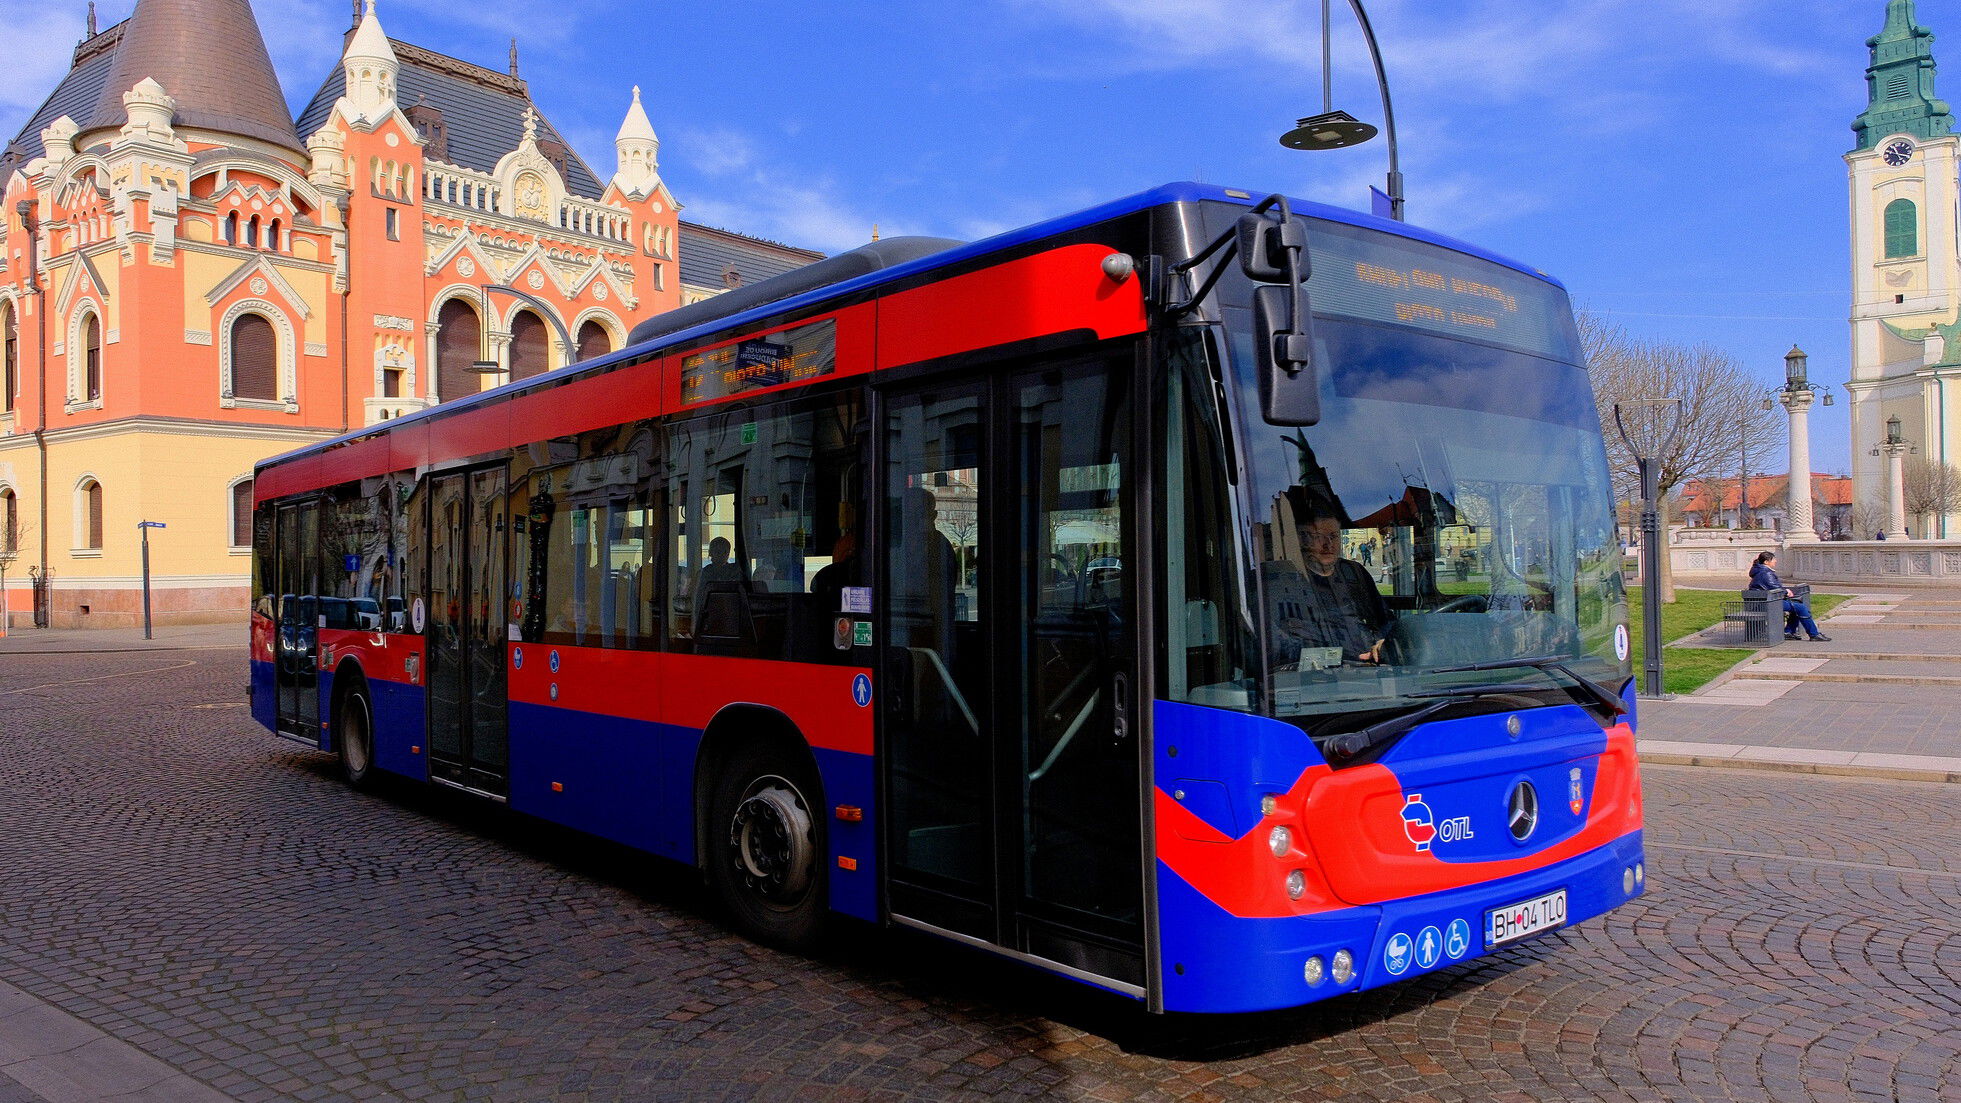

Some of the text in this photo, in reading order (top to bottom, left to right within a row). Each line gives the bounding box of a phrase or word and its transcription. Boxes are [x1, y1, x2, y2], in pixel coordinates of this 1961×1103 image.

[1439, 816, 1474, 843] OTL
[1495, 895, 1565, 939] BH 04 TLO
